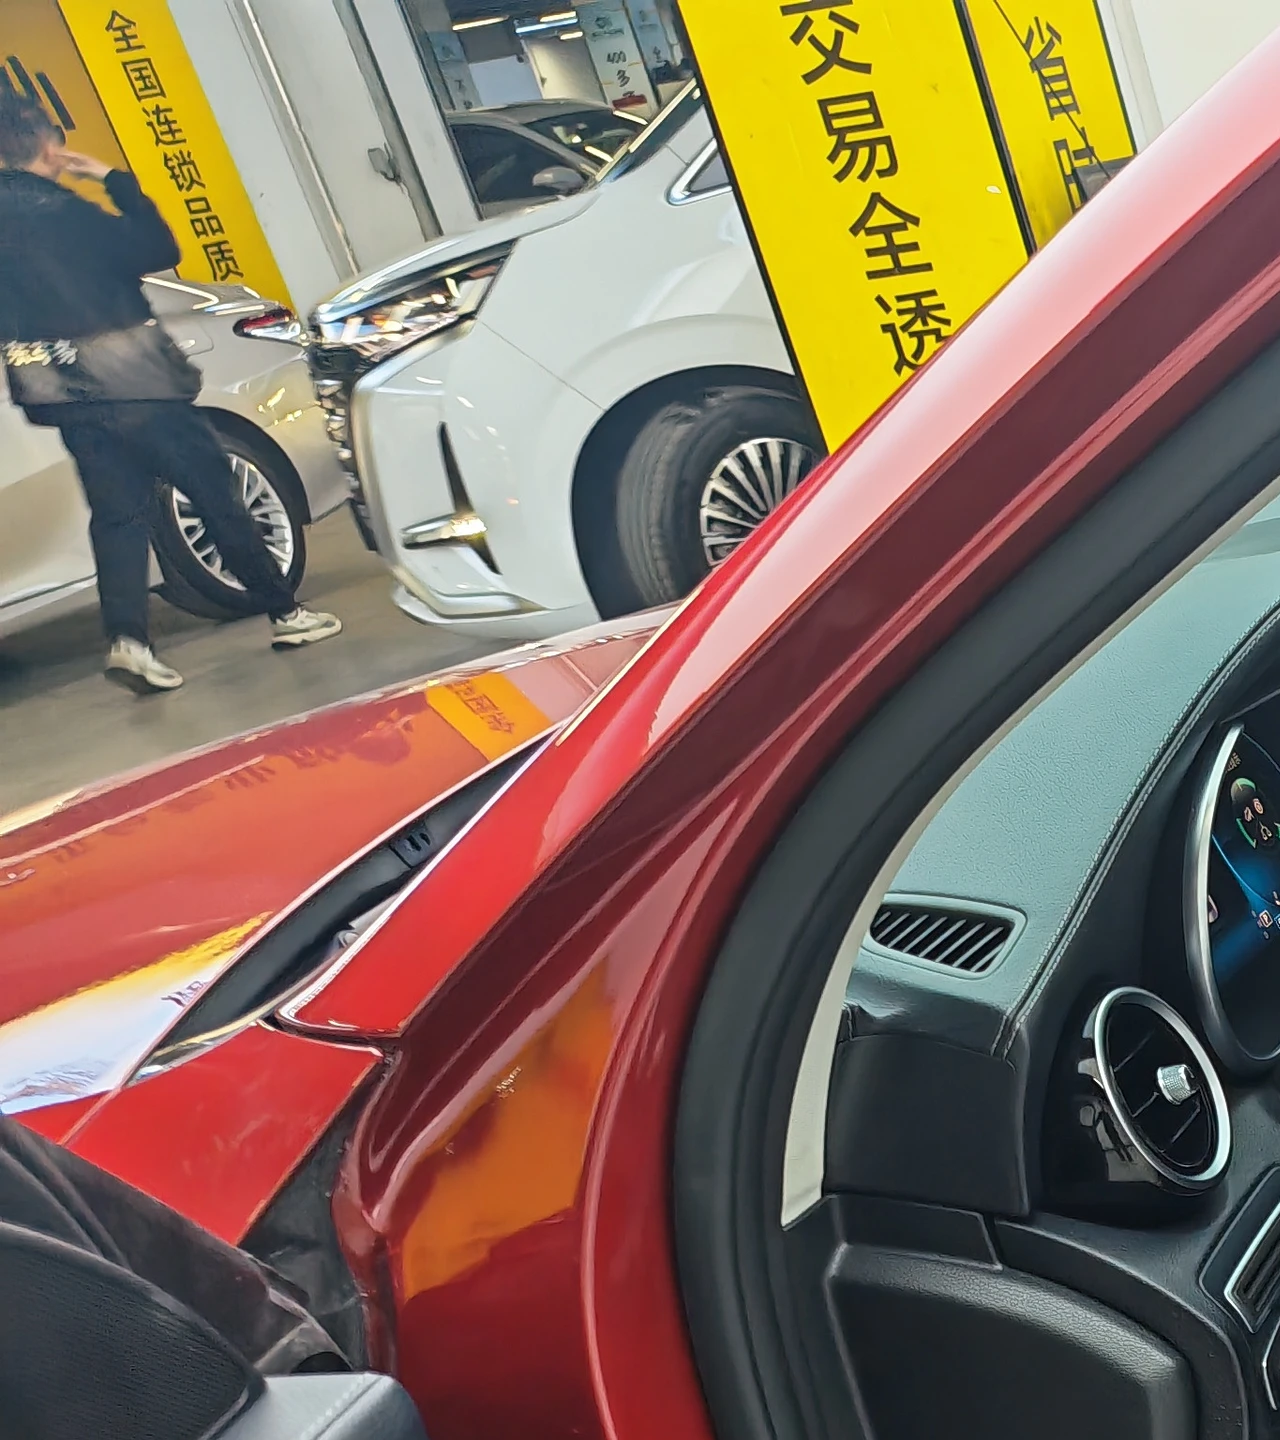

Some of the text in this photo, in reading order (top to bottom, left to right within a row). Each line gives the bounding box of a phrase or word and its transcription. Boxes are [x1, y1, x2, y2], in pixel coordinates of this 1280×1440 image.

[105, 10, 244, 282] 全国连锁品质
[780, 0, 952, 377] 交易全透
